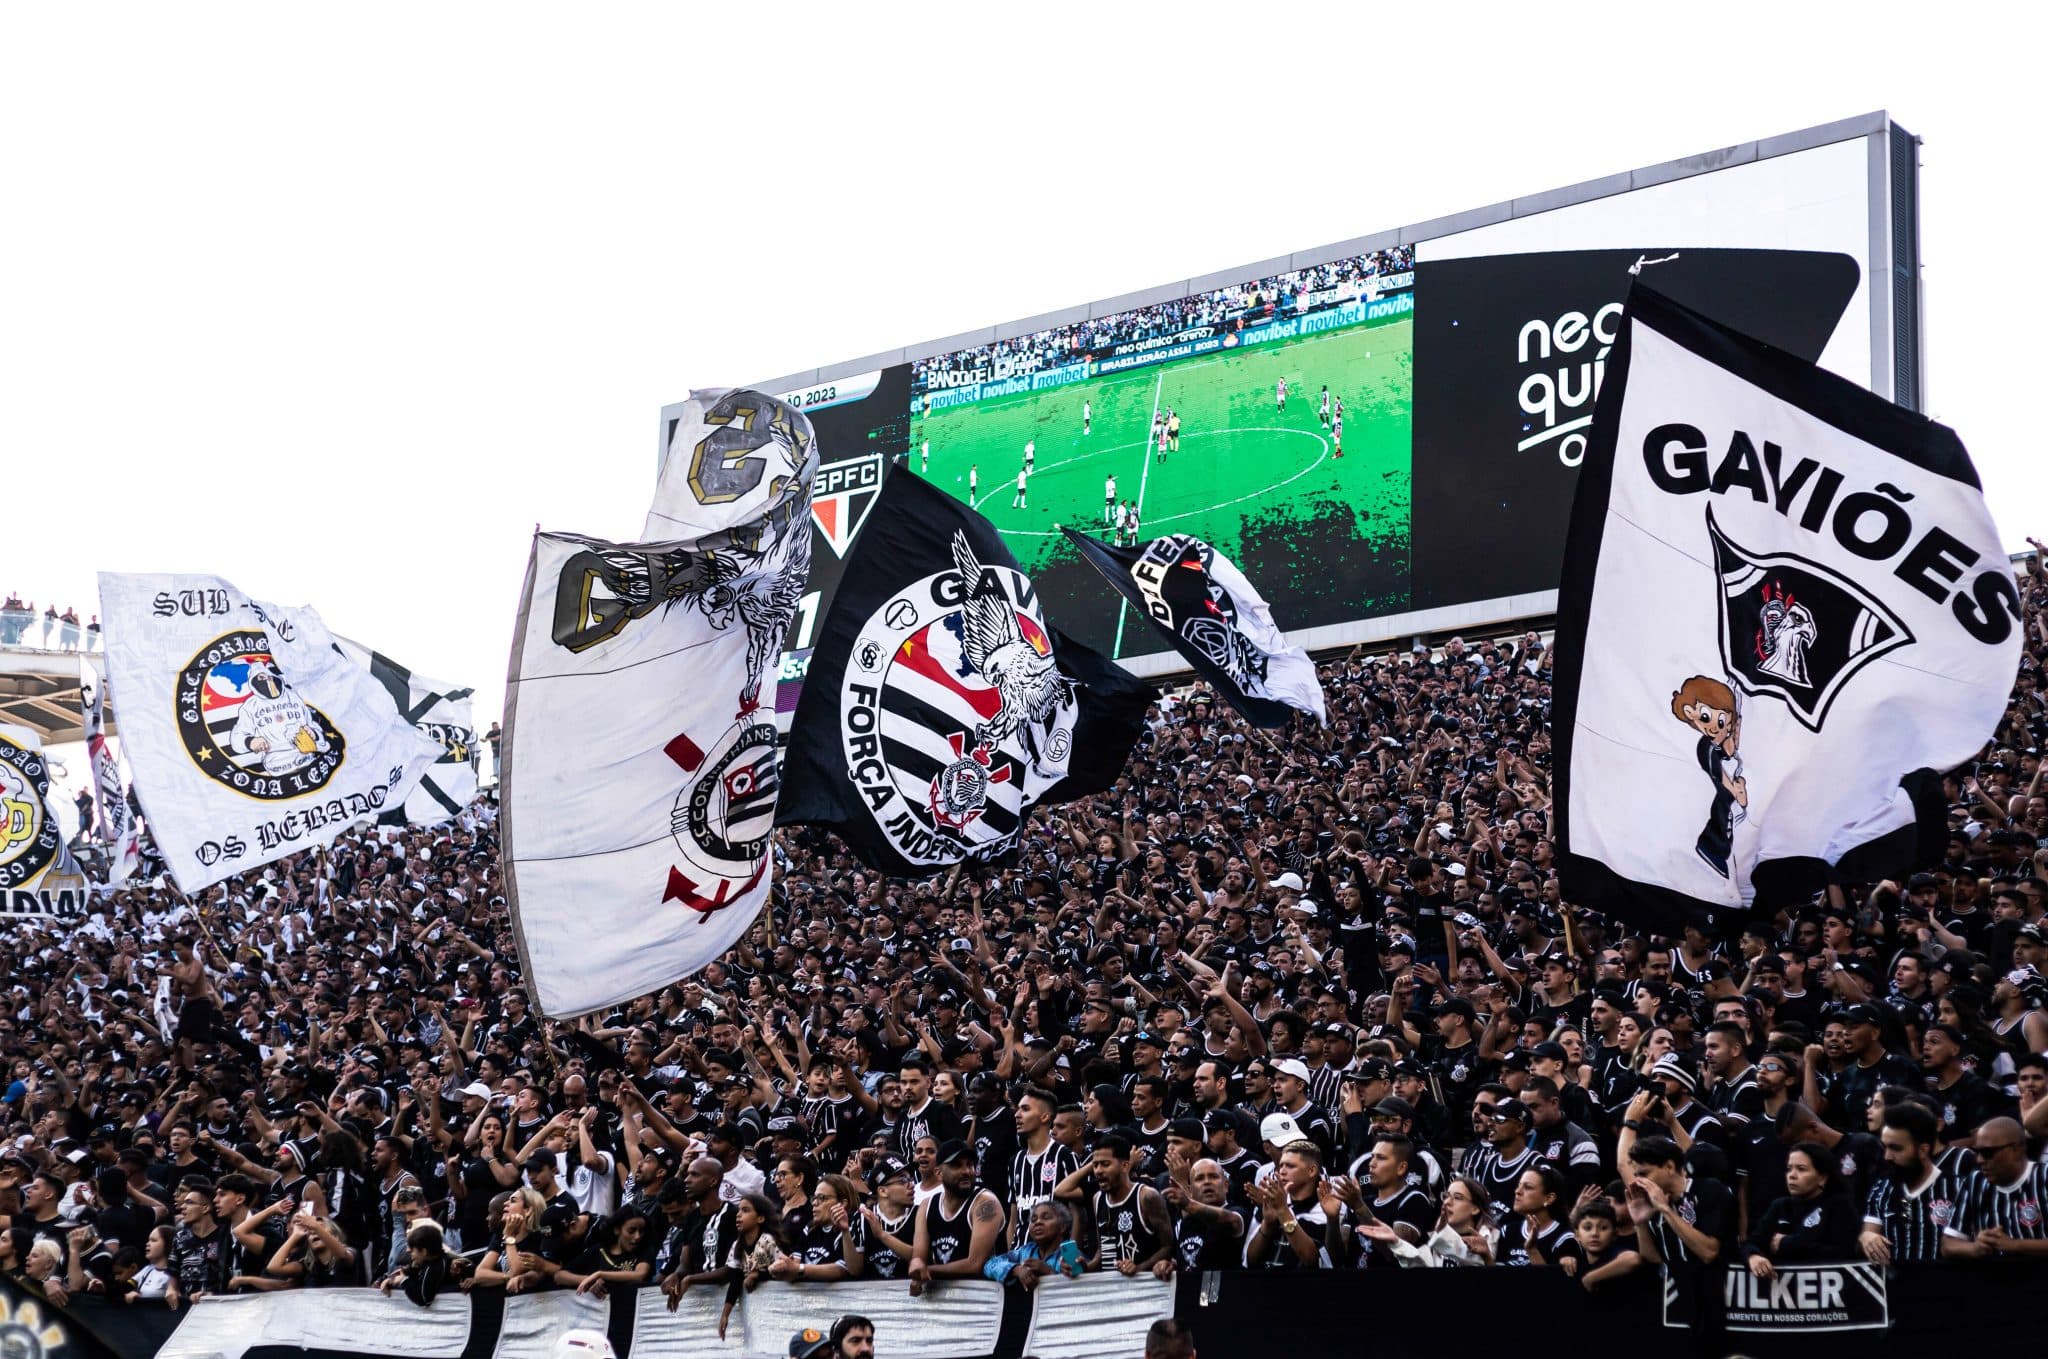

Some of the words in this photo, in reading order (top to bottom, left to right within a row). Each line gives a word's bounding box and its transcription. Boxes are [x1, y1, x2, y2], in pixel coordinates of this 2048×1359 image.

[1306, 304, 1361, 331] novibet
[1518, 302, 1625, 364] neo
[1115, 343, 1135, 356] neo
[1243, 322, 1299, 346] novibet
[983, 375, 1031, 399] novibet
[1037, 366, 1085, 389] novibet
[806, 386, 837, 405] 2023
[930, 389, 977, 409] novibet
[814, 464, 876, 495] SPFC
[1642, 423, 2022, 646] GAVIÕES
[152, 588, 230, 619] SUB
[795, 590, 822, 650] 1
[847, 683, 896, 813] FORÇA
[218, 765, 284, 797] ZONA
[694, 727, 772, 821] CORINTHIANS
[195, 835, 247, 867] OS
[255, 764, 404, 856] BÊBADOS
[1761, 1313, 1773, 1321] EM
[1774, 1314, 1805, 1322] NOSSOS
[1806, 1311, 1849, 1323] CORAÇÕES
